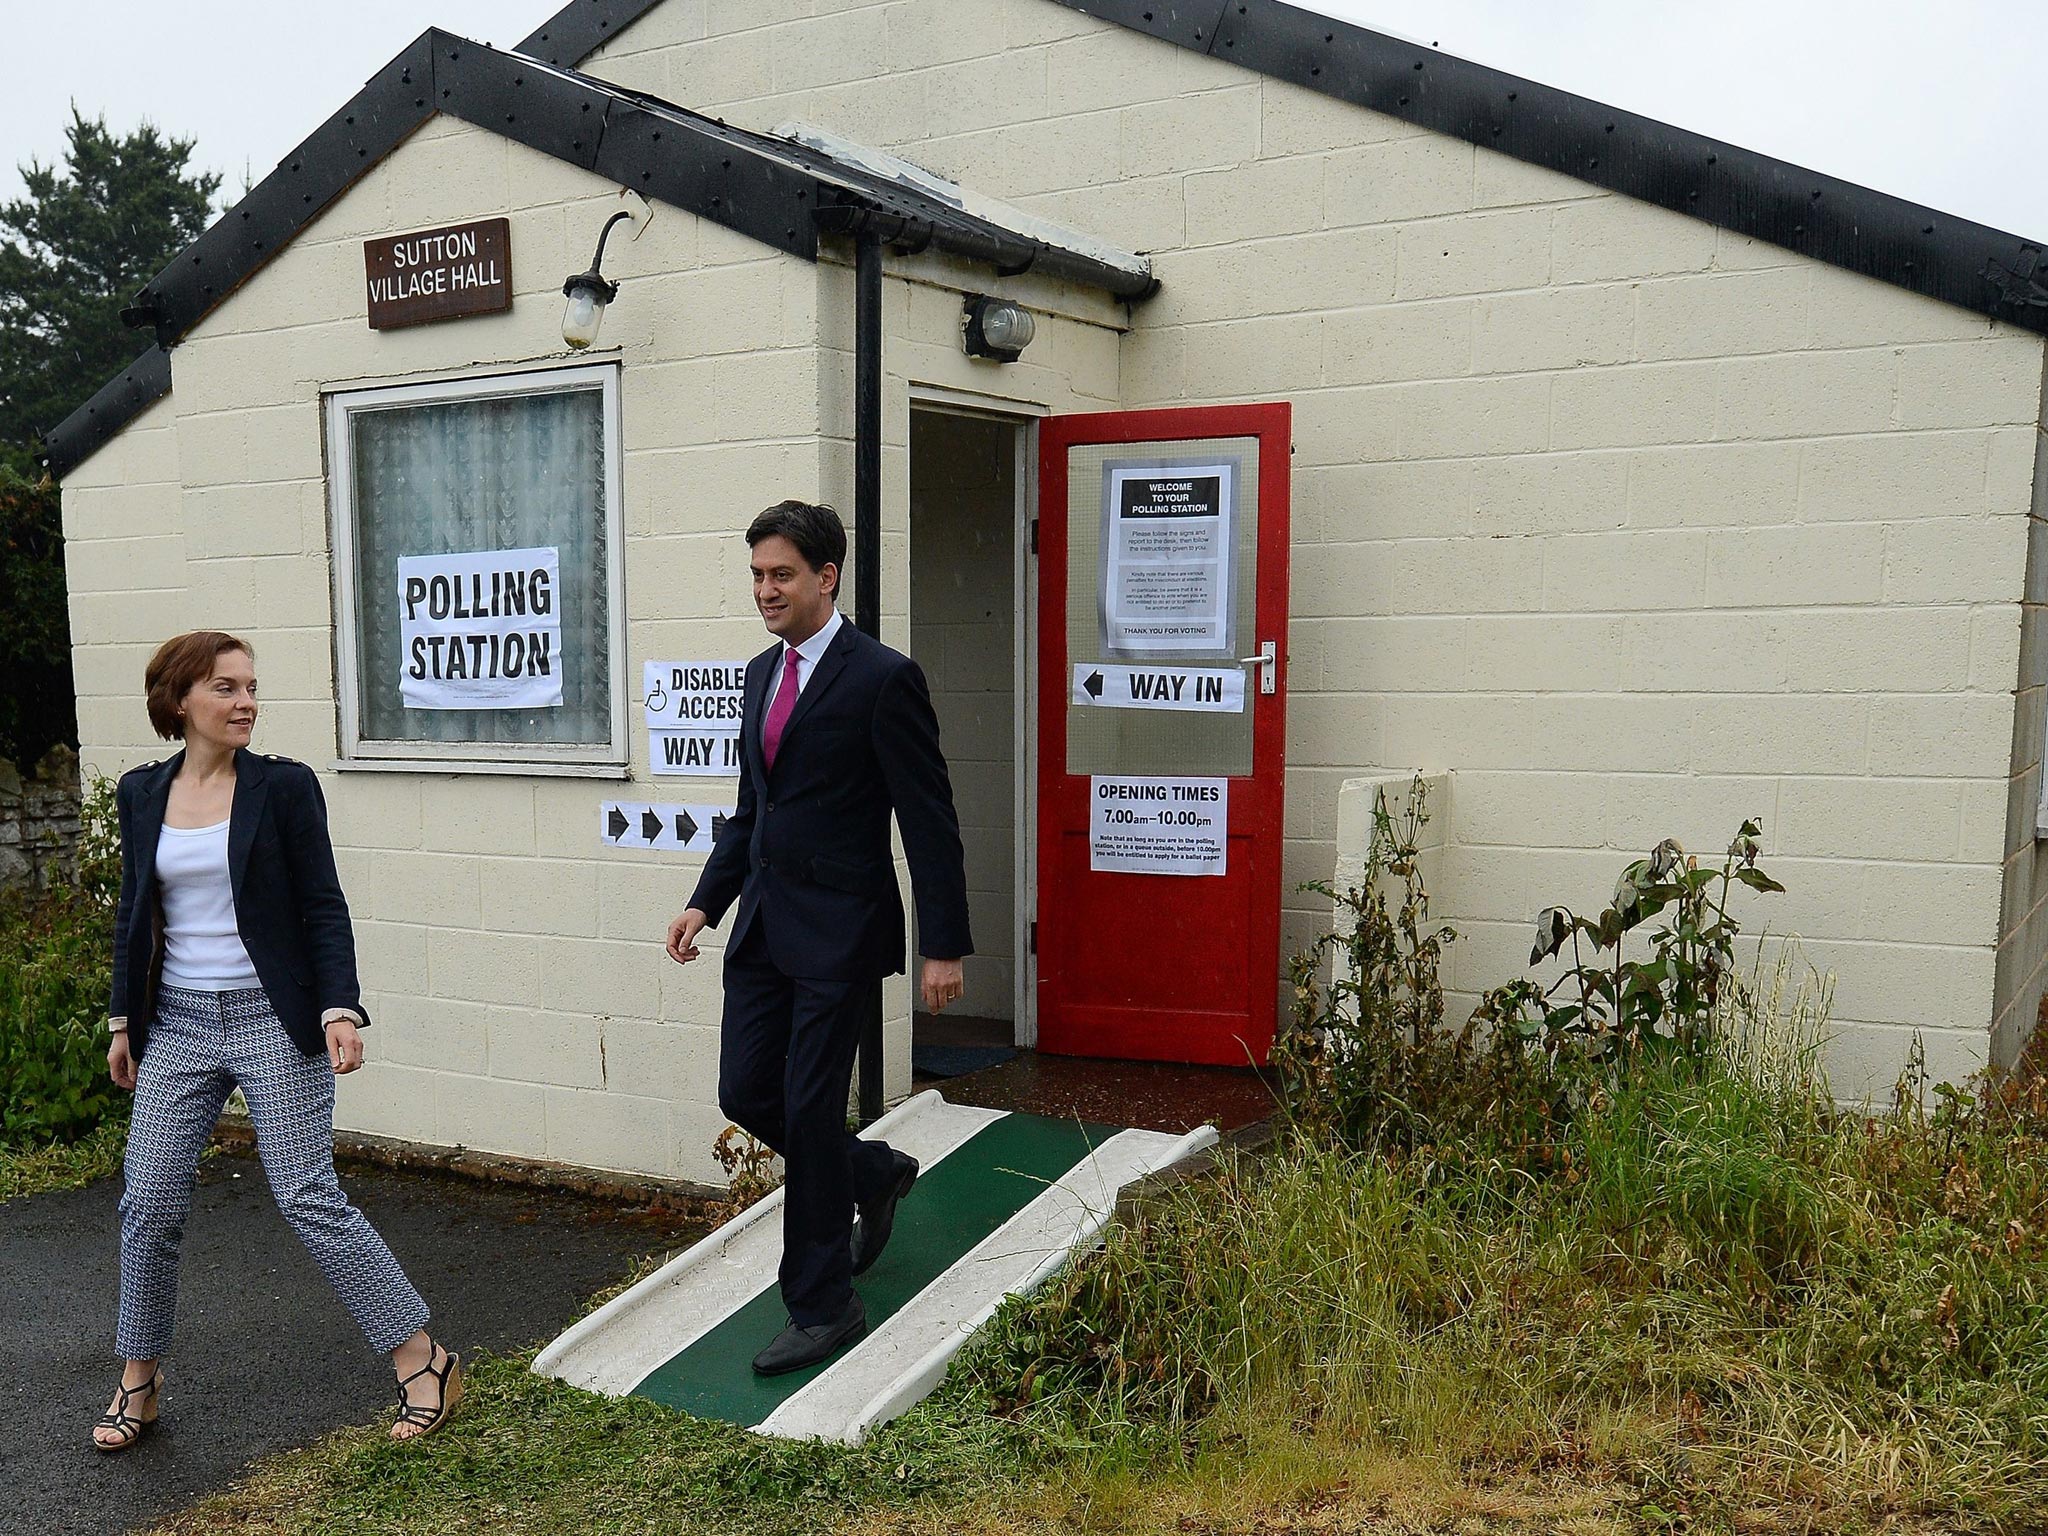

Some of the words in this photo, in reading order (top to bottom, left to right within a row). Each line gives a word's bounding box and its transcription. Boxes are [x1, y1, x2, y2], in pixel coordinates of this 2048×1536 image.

[394, 231, 476, 269] SUTTON
[369, 268, 446, 303] VILLAGE
[451, 260, 501, 291] HALL
[1150, 482, 1192, 492] WELCOME
[1152, 494, 1164, 502] TO
[1165, 494, 1189, 502] YOUR
[1132, 505, 1169, 514] POLLING
[1170, 504, 1208, 512] STATION
[406, 568, 551, 620] POLLING
[409, 632, 551, 680] STATION
[672, 668, 744, 691] DISABLE
[1129, 674, 1186, 701] WAY
[1196, 677, 1222, 702] IN
[663, 737, 714, 766] WAY
[1098, 784, 1167, 800] OPENING
[1172, 786, 1219, 801] TIMES
